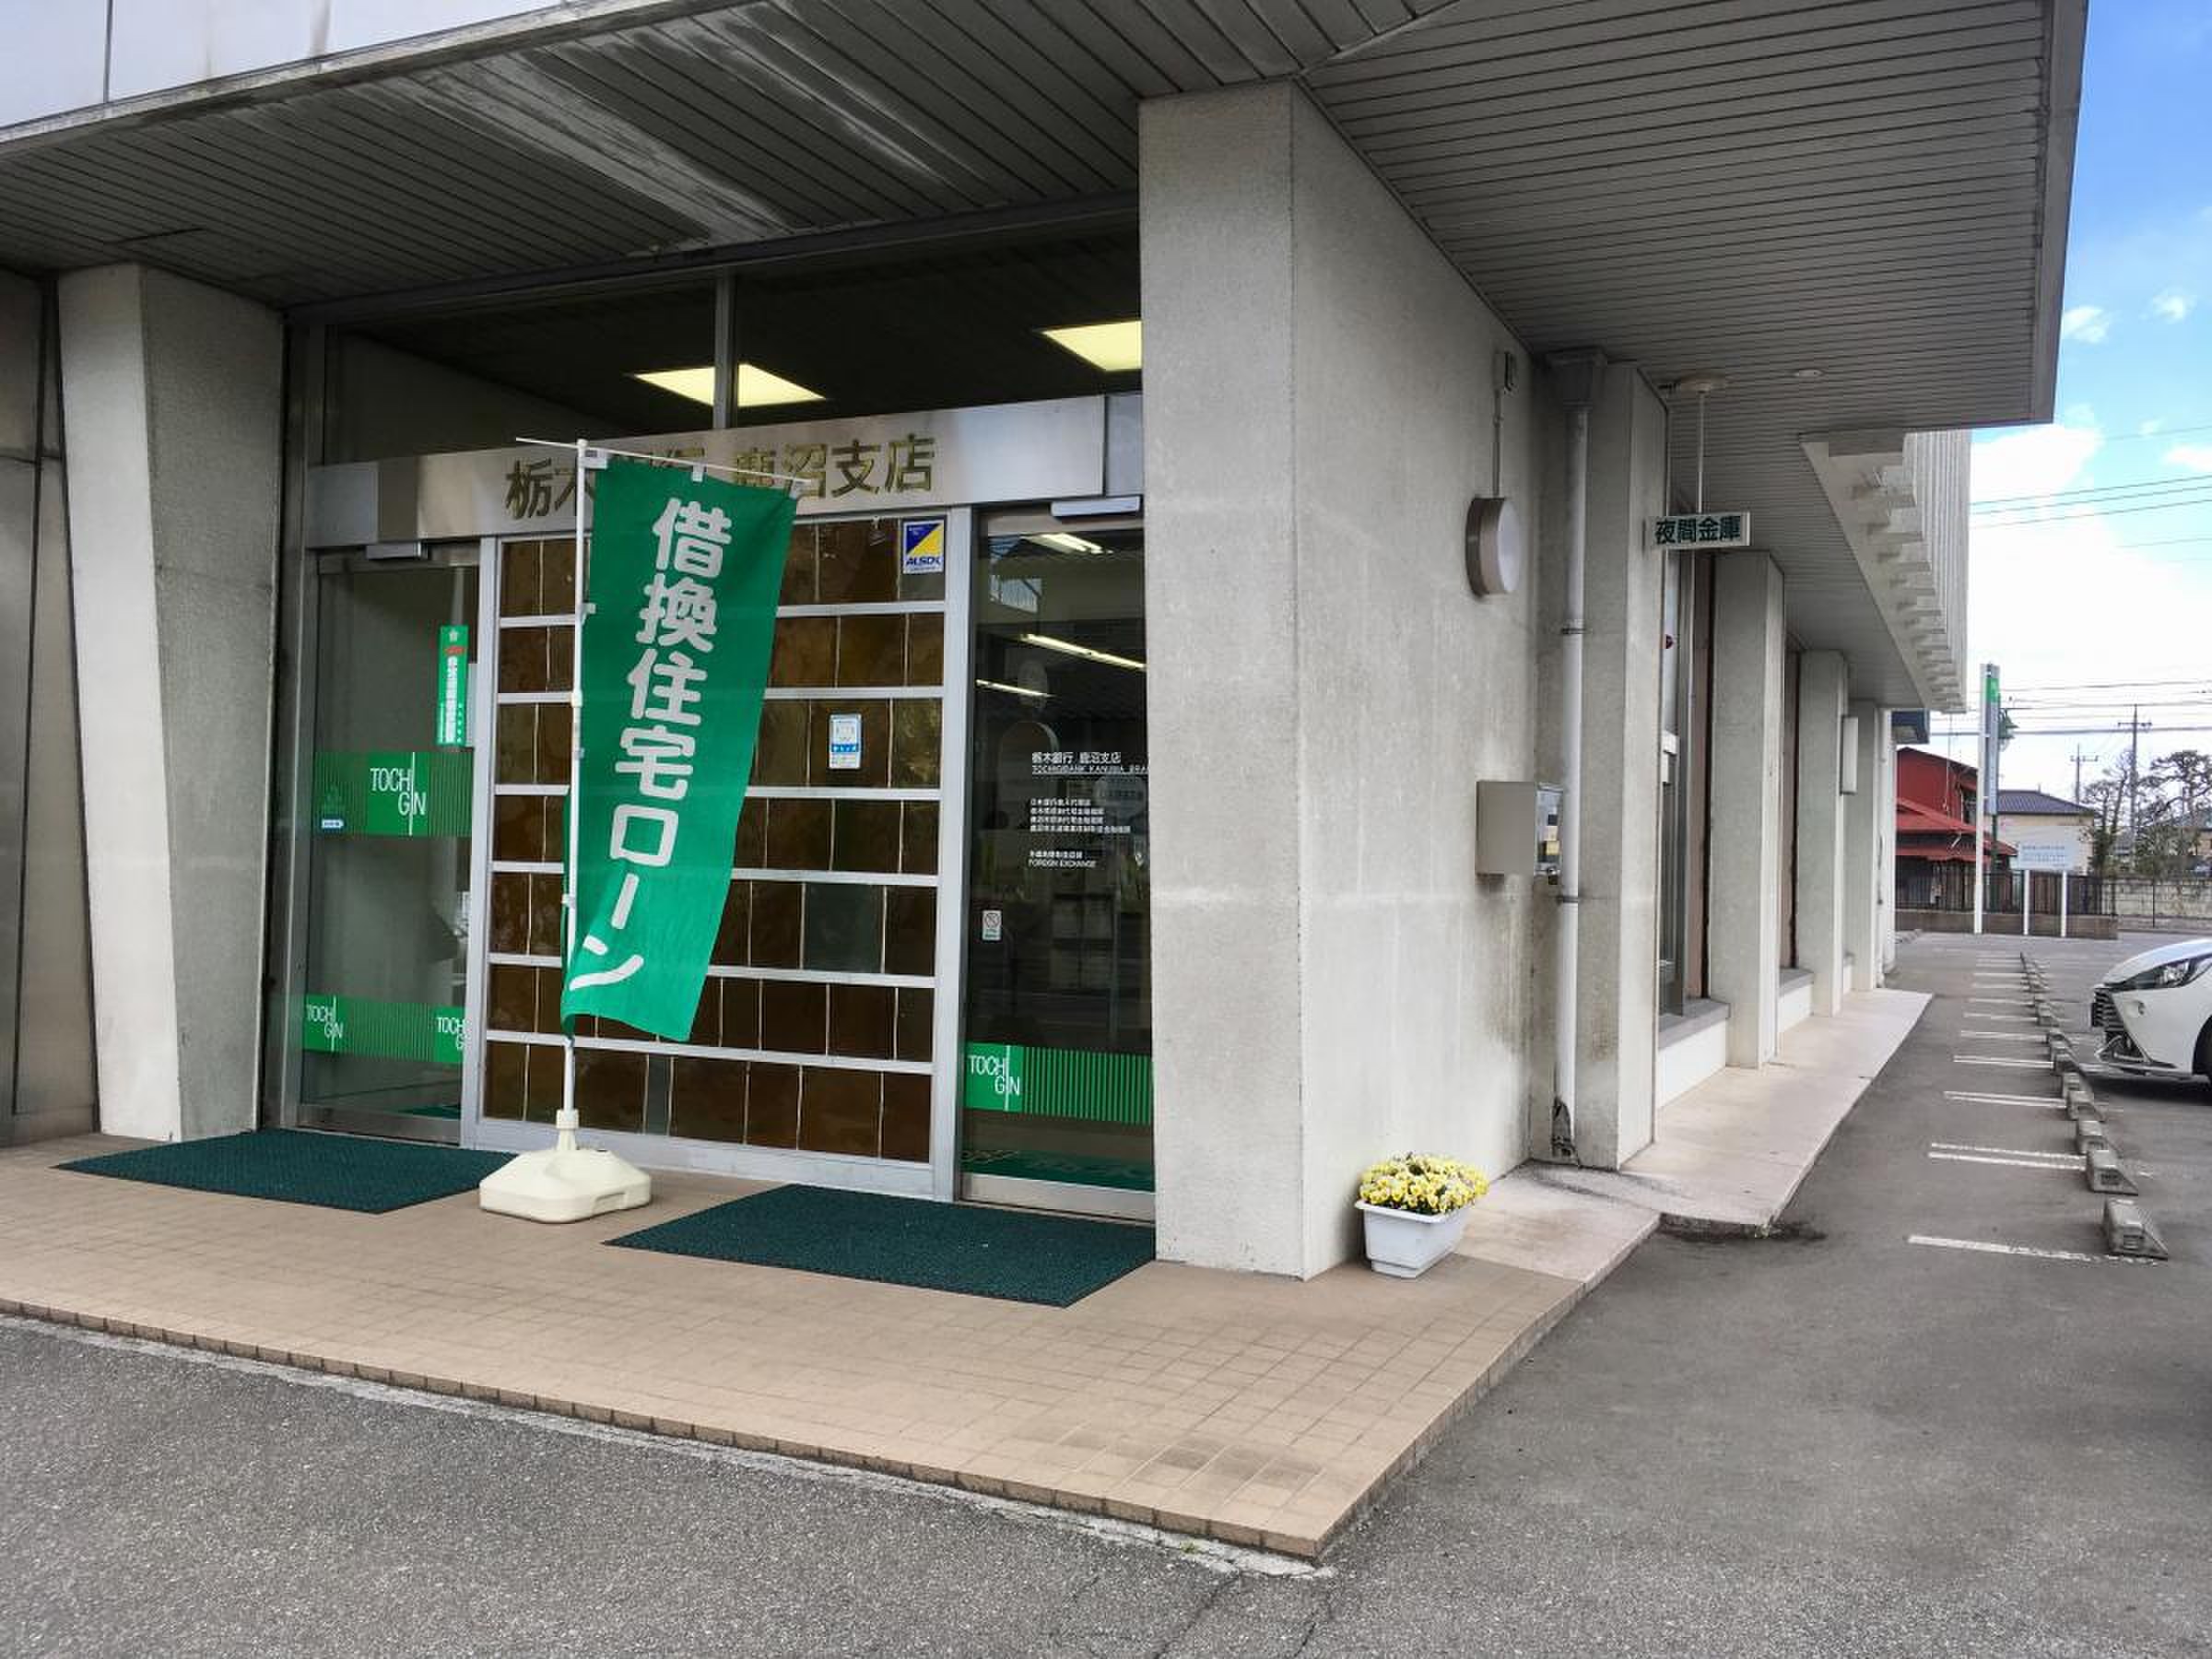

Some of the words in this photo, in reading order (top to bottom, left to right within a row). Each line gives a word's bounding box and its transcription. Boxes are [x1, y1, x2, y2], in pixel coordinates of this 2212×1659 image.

[1655, 516, 1740, 544] 夜間金庫
[570, 497, 732, 991] 借換住宅ローン
